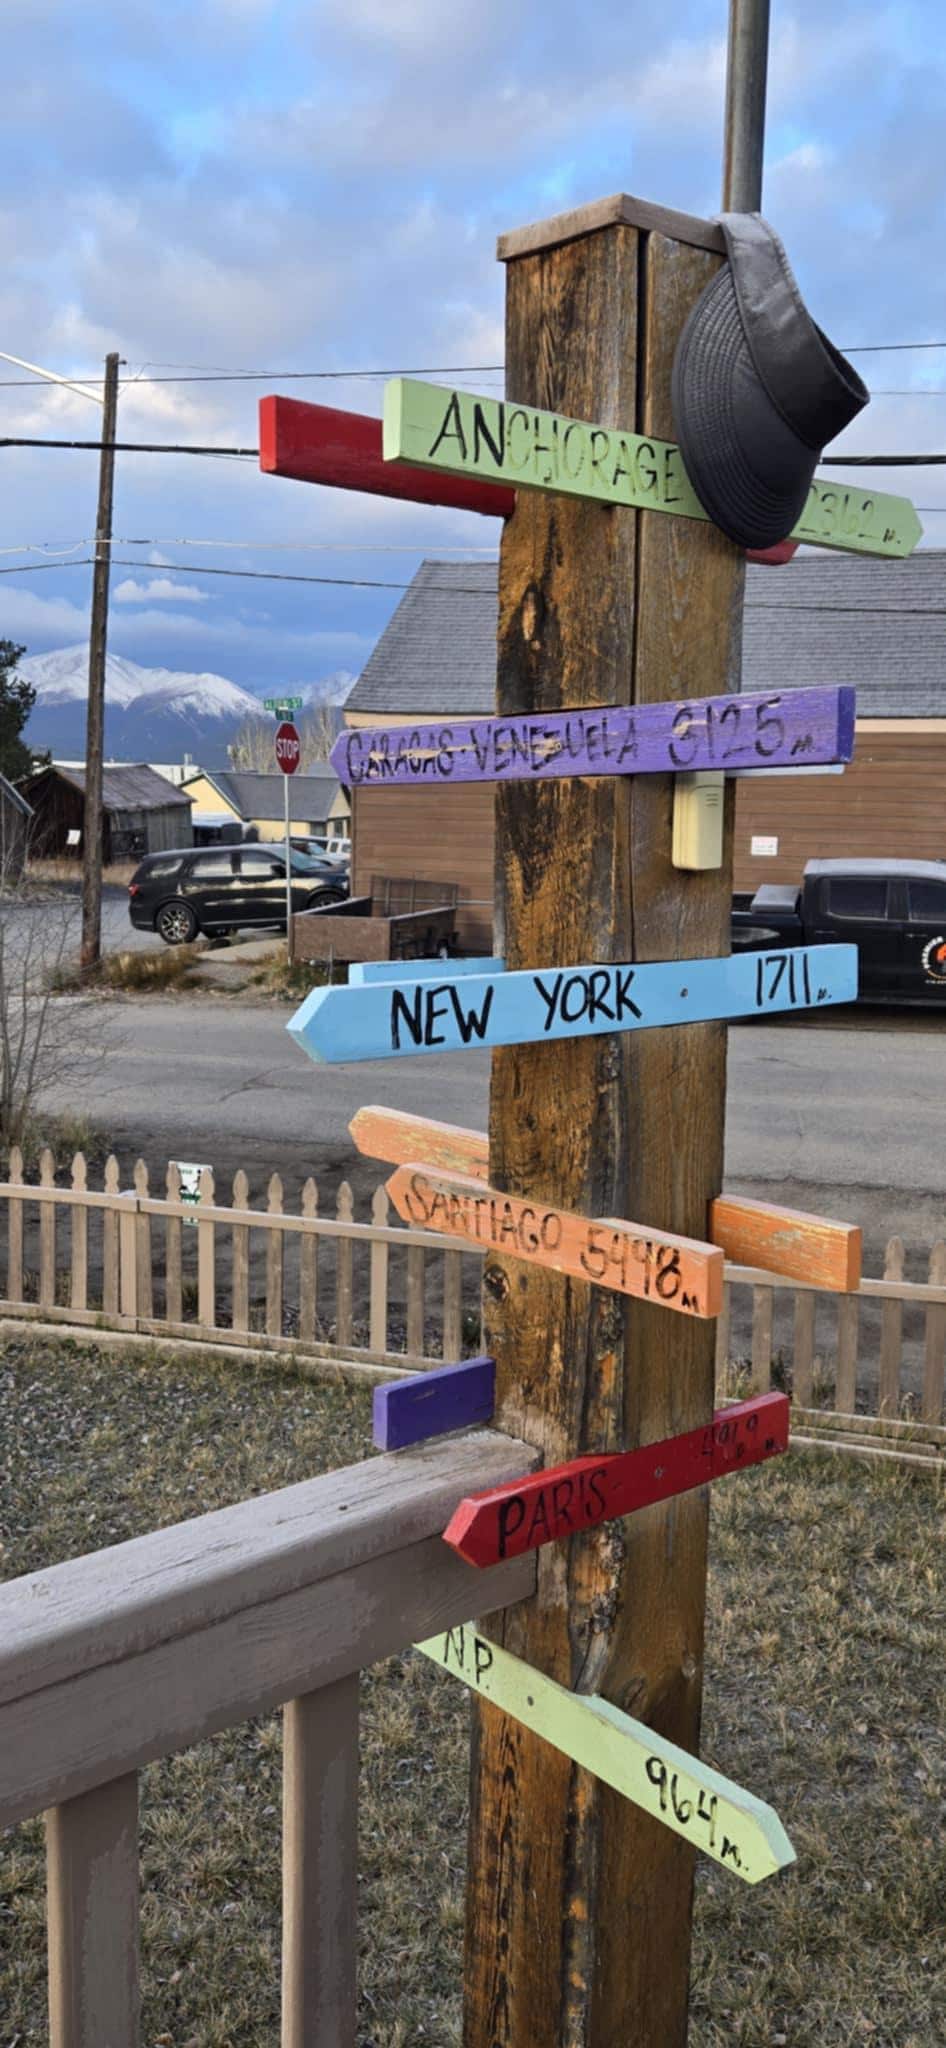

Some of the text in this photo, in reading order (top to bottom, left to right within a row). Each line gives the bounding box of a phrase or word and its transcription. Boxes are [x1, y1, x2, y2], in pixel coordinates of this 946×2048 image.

[429, 391, 679, 503] ANCHORAGE
[277, 738, 299, 760] STOP
[669, 697, 785, 766] 3125
[391, 985, 495, 1050] NEW
[533, 969, 642, 1031] YORK
[757, 953, 811, 1006] 1711
[405, 1174, 562, 1252] SANTIAGO
[580, 1227, 683, 1299] 5498
[645, 1756, 718, 1847] 964
